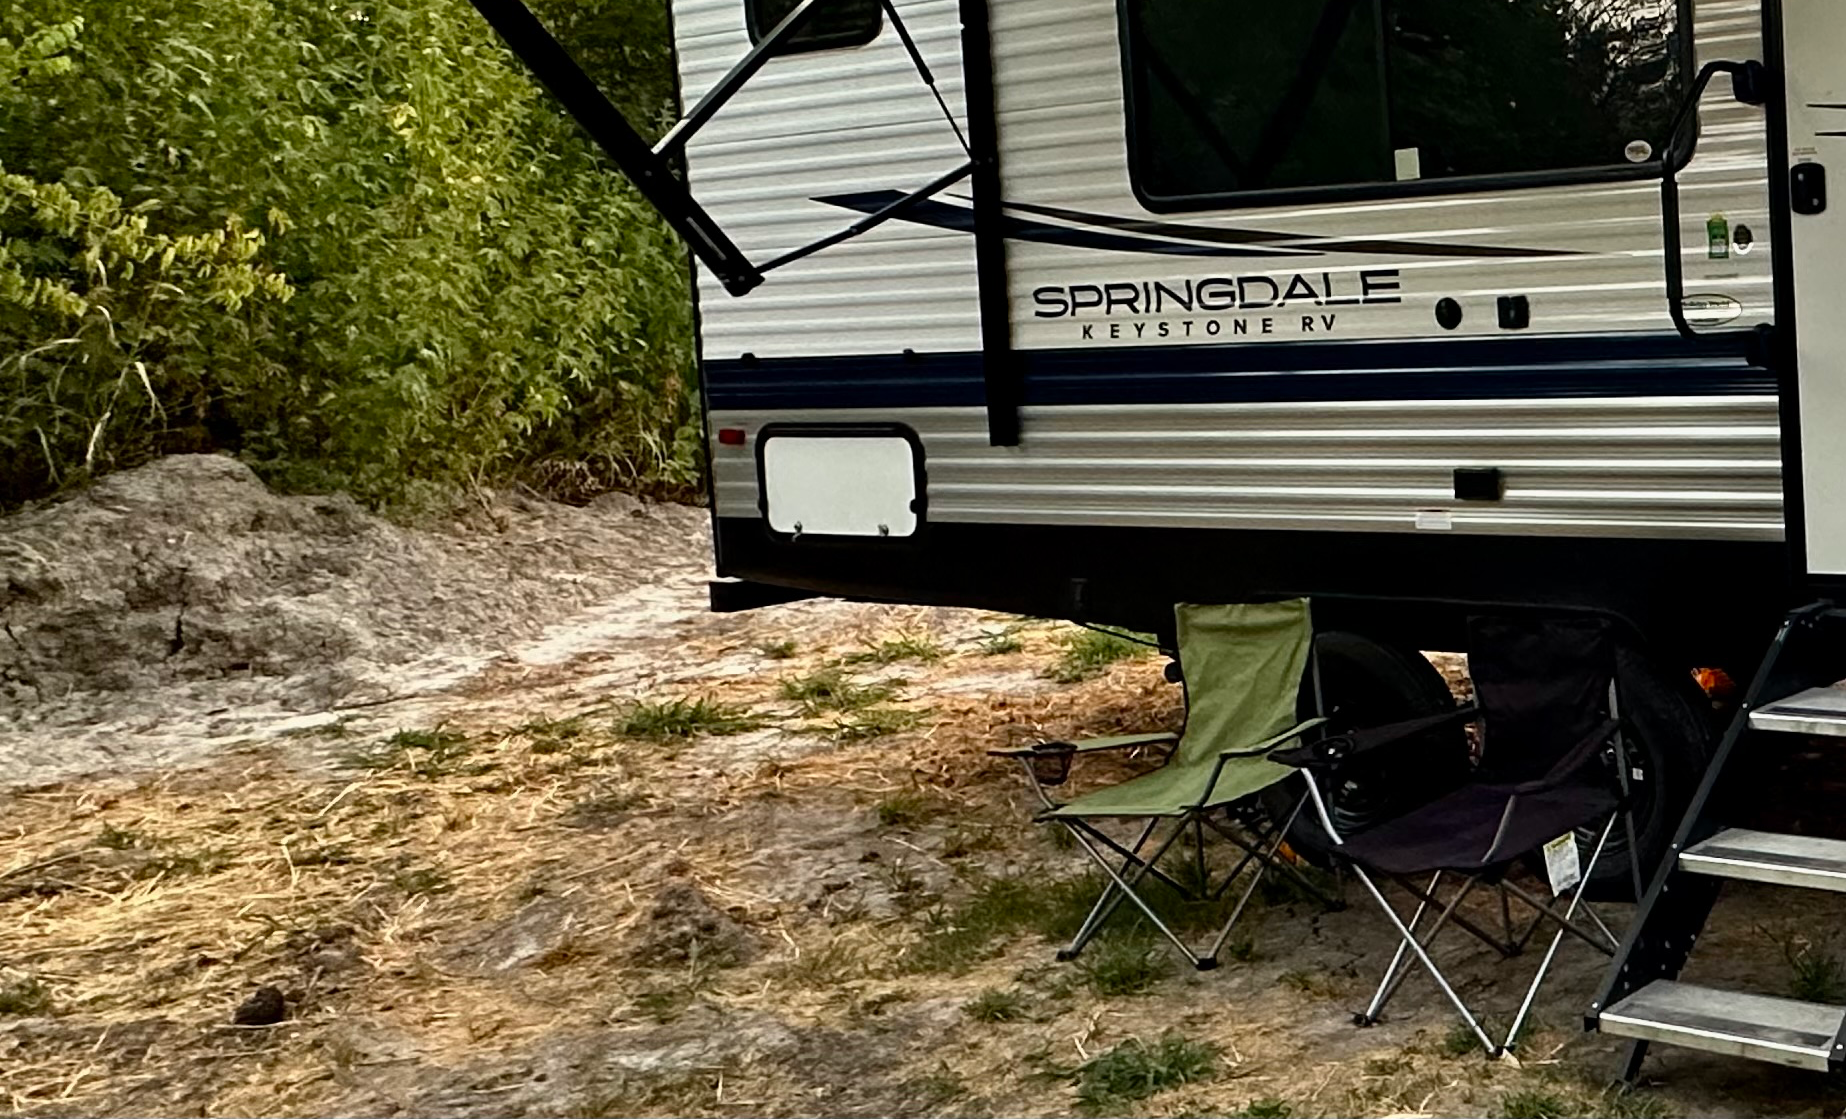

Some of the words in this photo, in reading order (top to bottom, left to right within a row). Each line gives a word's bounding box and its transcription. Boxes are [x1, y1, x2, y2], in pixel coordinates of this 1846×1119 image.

[1032, 269, 1401, 317] SPRINGDALE
[1082, 318, 1274, 340] KEYSTONE
[1302, 314, 1337, 332] RV
